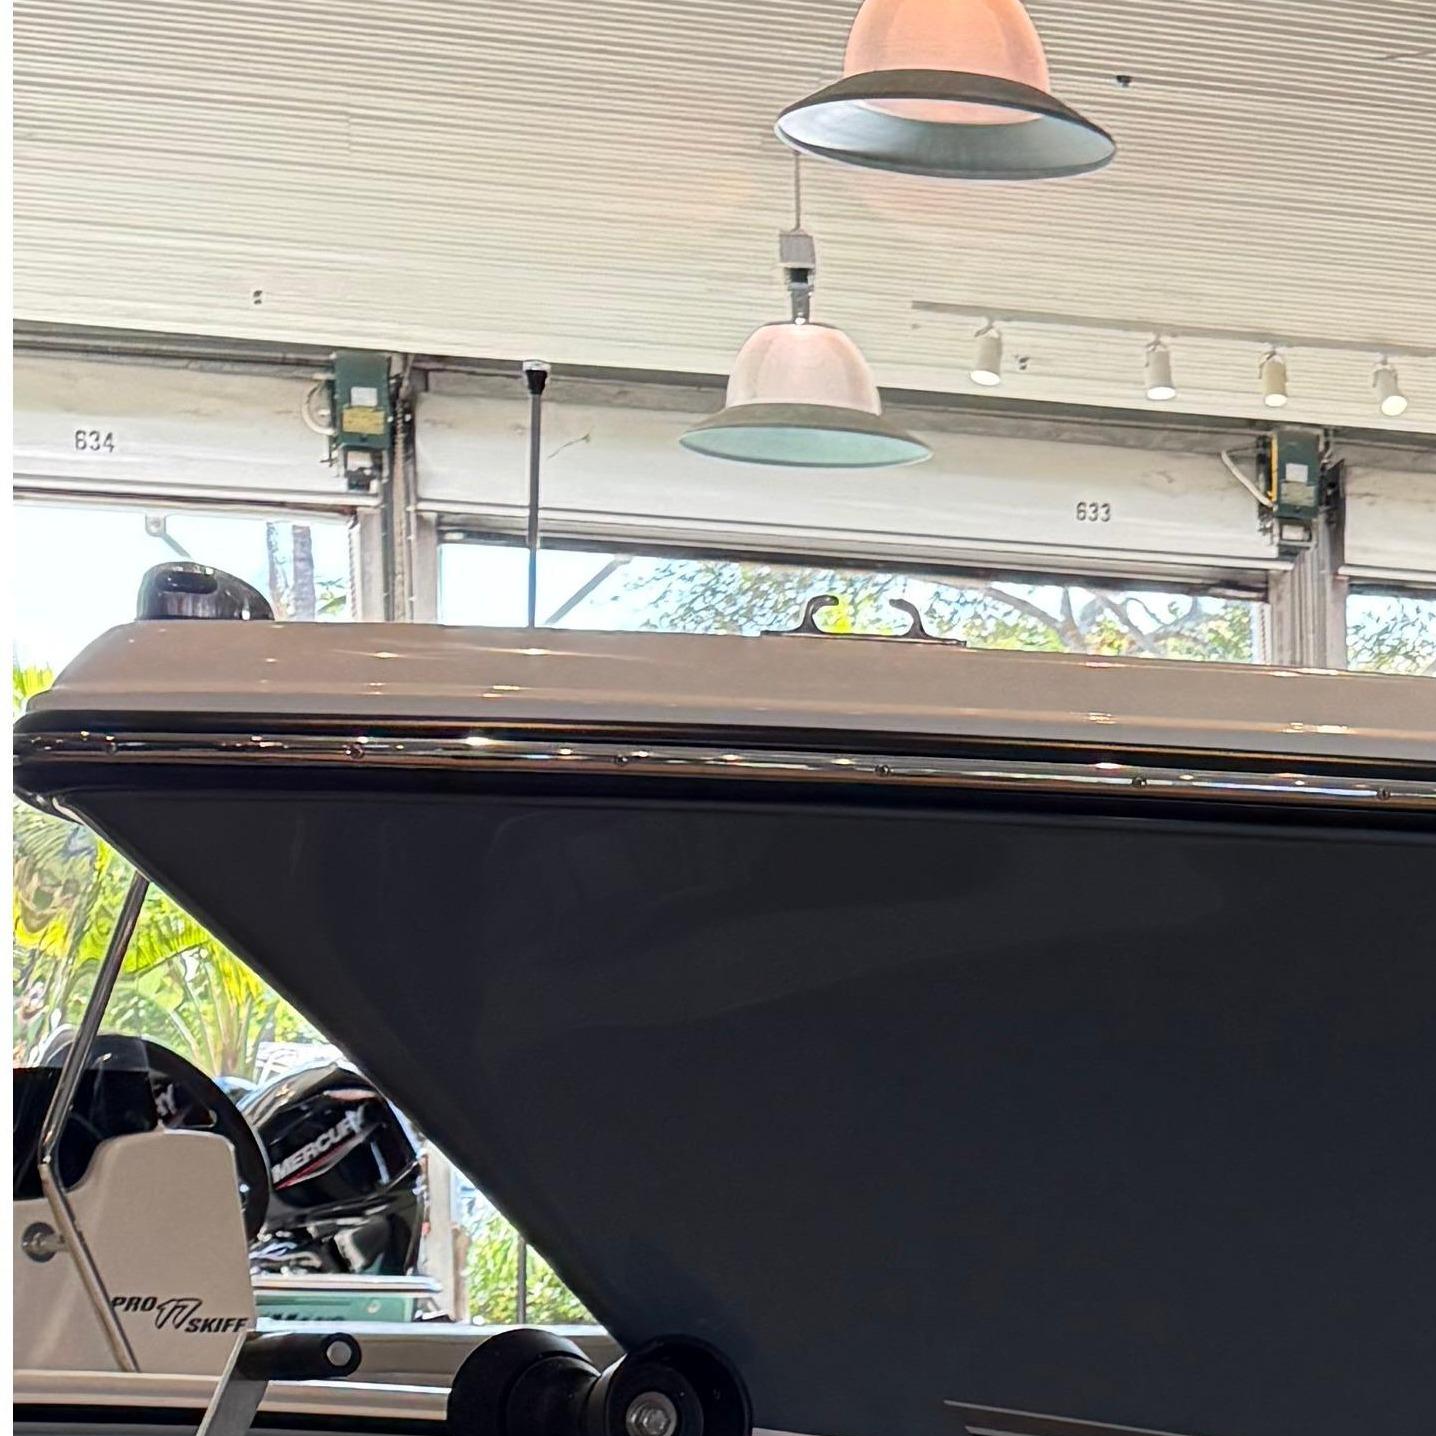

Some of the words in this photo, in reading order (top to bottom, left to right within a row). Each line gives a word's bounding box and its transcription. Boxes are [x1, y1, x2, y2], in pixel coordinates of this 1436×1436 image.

[75, 429, 115, 453] 634
[1076, 501, 1111, 522] 633
[271, 1103, 367, 1185] MERCURY
[110, 1296, 157, 1313] PRO
[155, 1298, 203, 1330] 17
[184, 1316, 249, 1333] SKIFF
